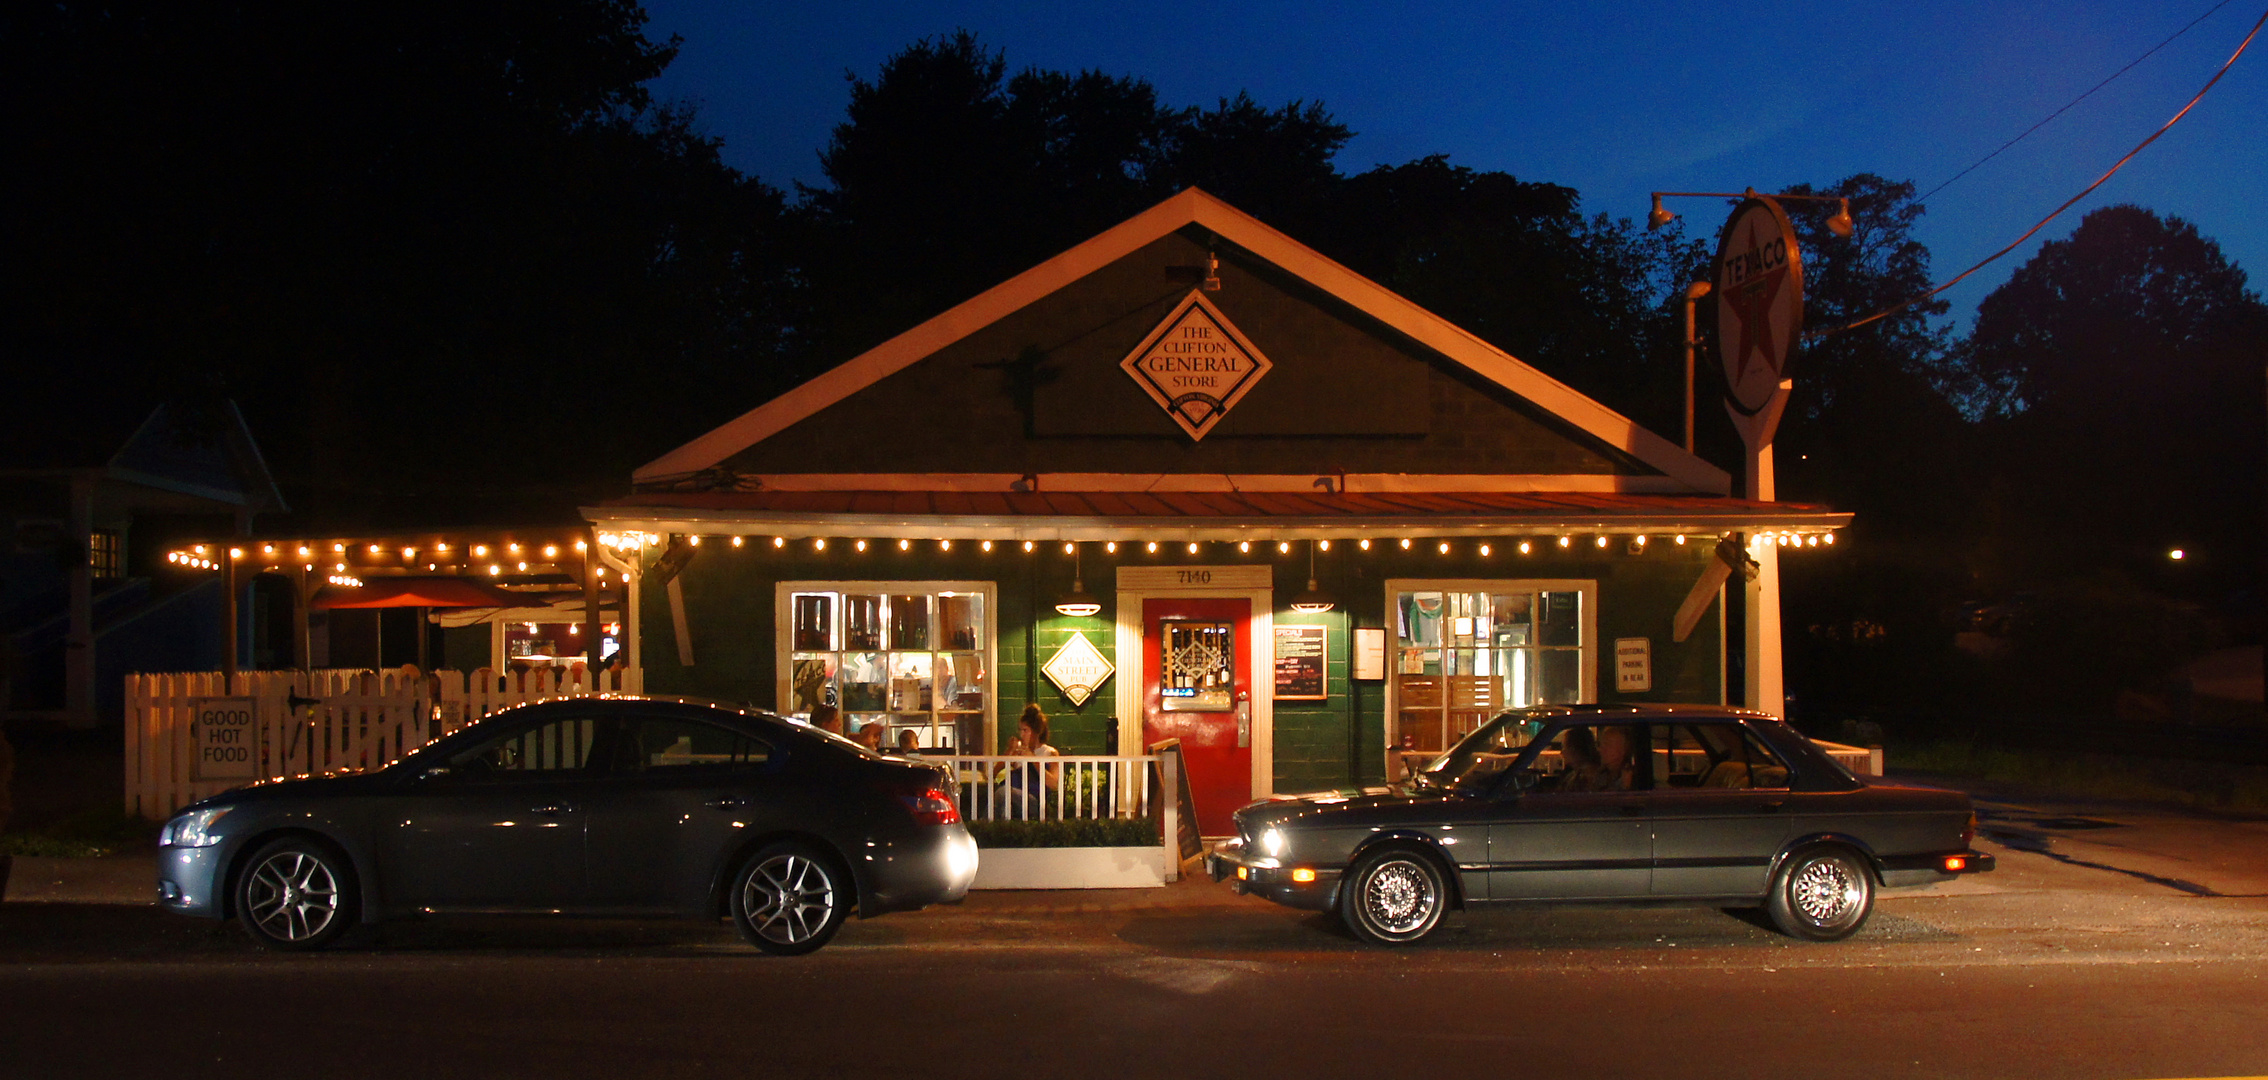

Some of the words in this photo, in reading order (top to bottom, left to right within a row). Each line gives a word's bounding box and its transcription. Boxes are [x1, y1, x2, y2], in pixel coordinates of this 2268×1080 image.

[1726, 237, 1786, 283] TEXACO
[1180, 327, 1212, 339] THE
[1164, 342, 1227, 354] CLIFTON
[1149, 356, 1242, 373] GENERAL
[1172, 376, 1219, 387] STORE
[1177, 570, 1211, 584] 7140
[1275, 629, 1303, 637] SPECIALS
[1063, 656, 1094, 665] MAIN
[1622, 660, 1643, 668] PARKING
[1058, 666, 1099, 675] STREET
[203, 710, 249, 725] GOOD
[210, 729, 242, 744] HOT
[204, 747, 248, 762] FOOD
